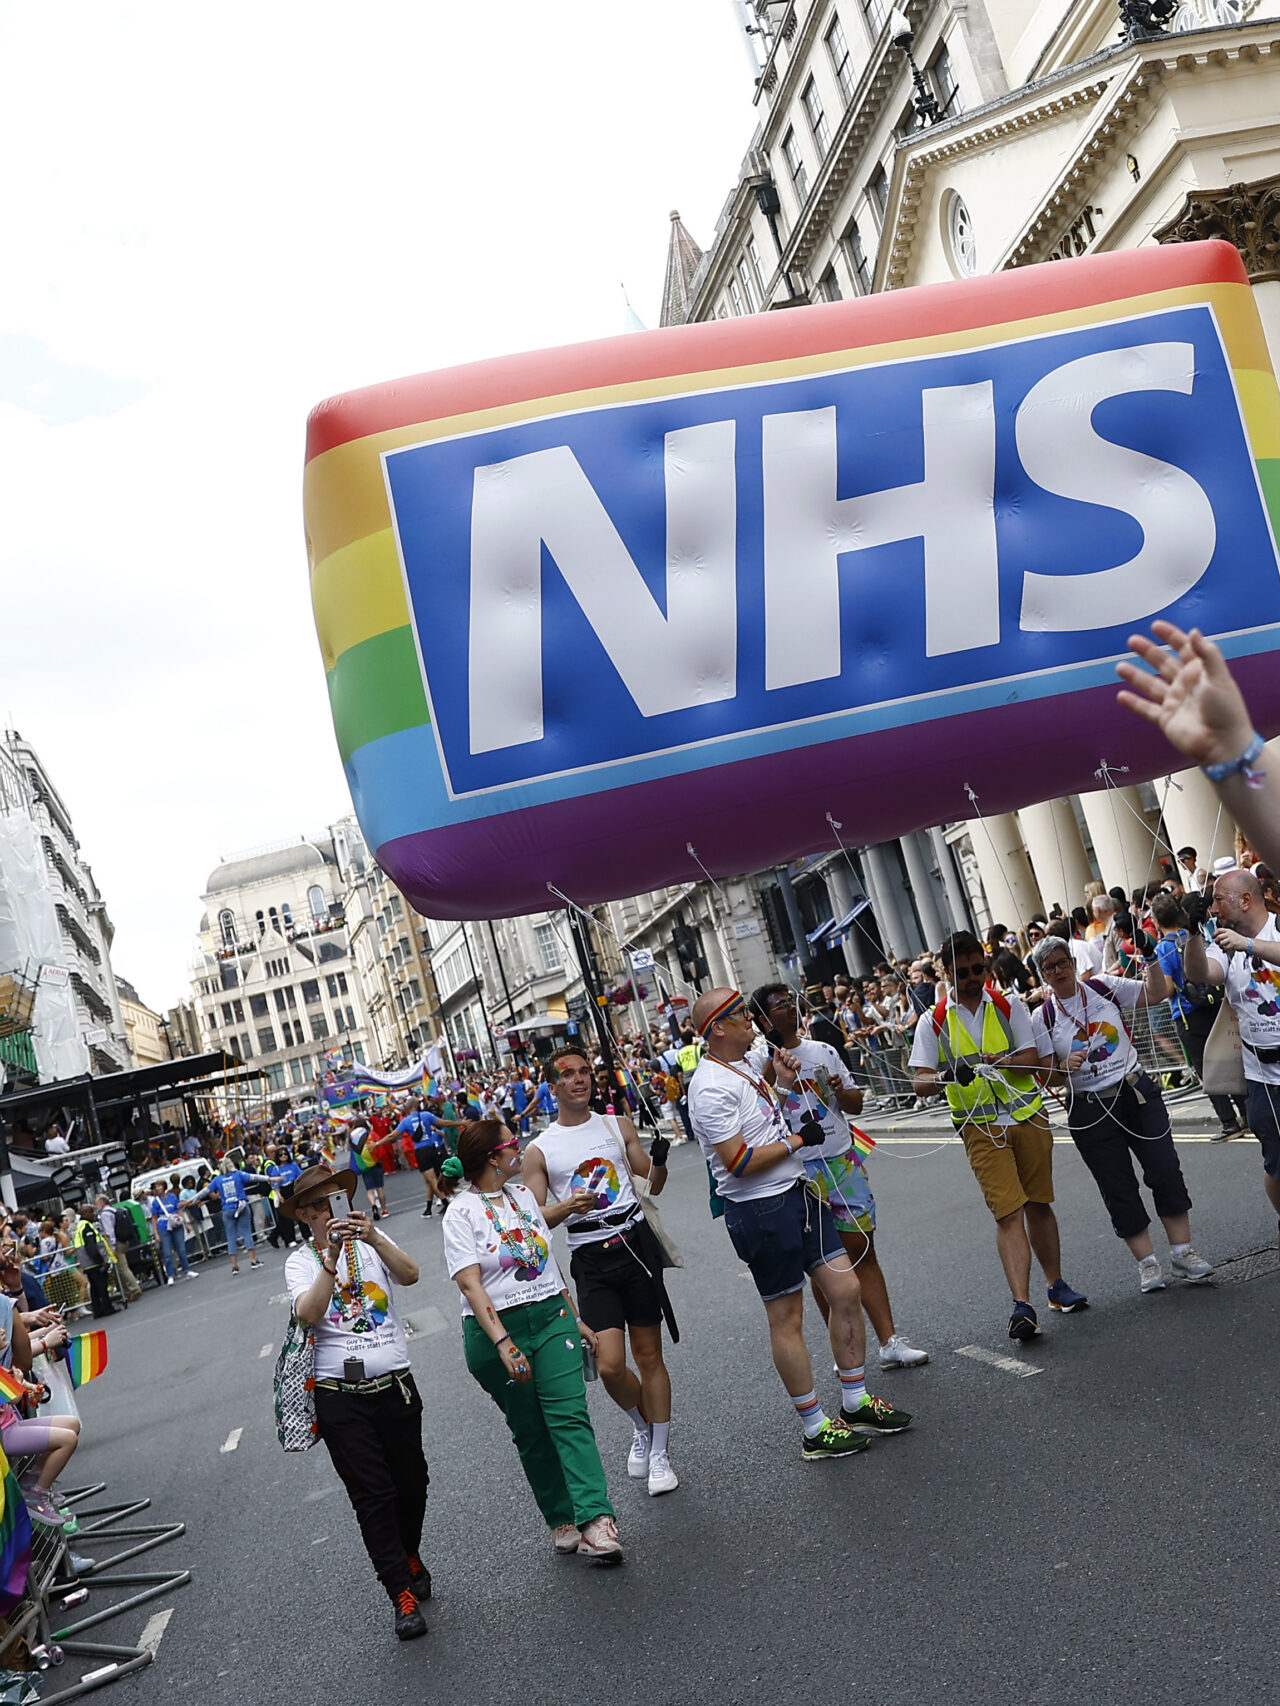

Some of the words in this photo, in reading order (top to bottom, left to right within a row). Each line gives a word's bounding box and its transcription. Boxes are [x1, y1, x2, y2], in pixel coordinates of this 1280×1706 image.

[469, 341, 1217, 755] NHS
[504, 1290, 521, 1300] Guy's
[346, 1344, 365, 1352] LGBT+
